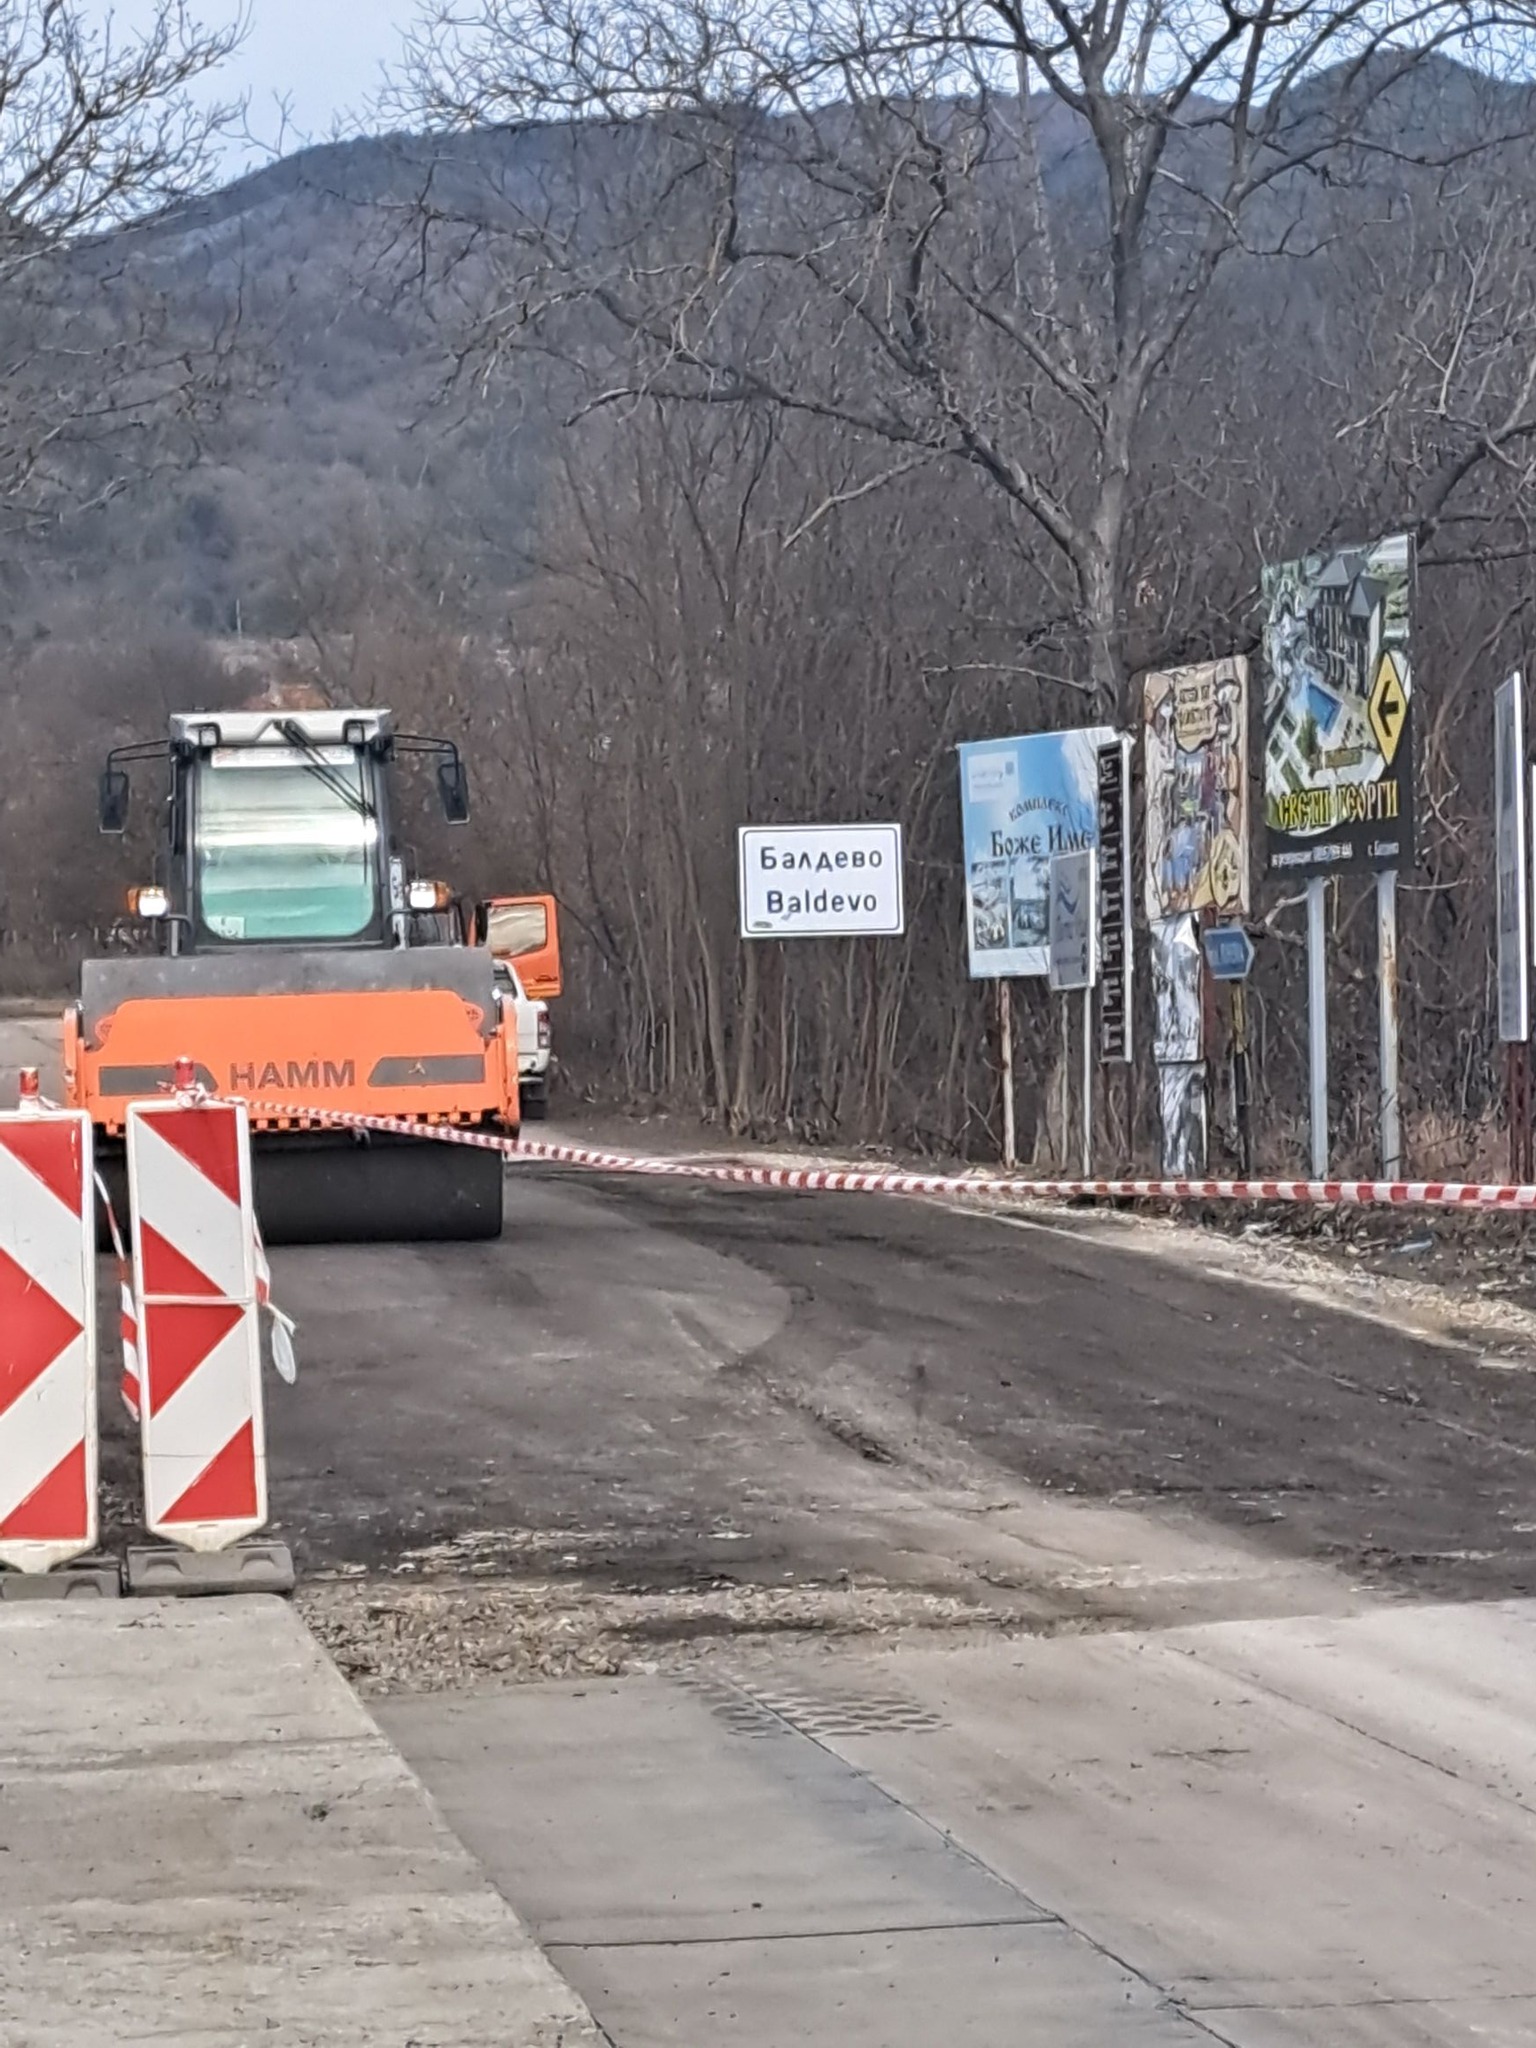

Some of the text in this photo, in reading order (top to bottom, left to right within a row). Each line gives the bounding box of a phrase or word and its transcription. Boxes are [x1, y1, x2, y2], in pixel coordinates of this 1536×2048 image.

[1336, 779, 1398, 822] ГЕОРГИ
[991, 829, 1041, 857] Боже
[760, 846, 883, 873] Балдево
[767, 888, 877, 914] Baldevo
[229, 1059, 356, 1091] HAMM
